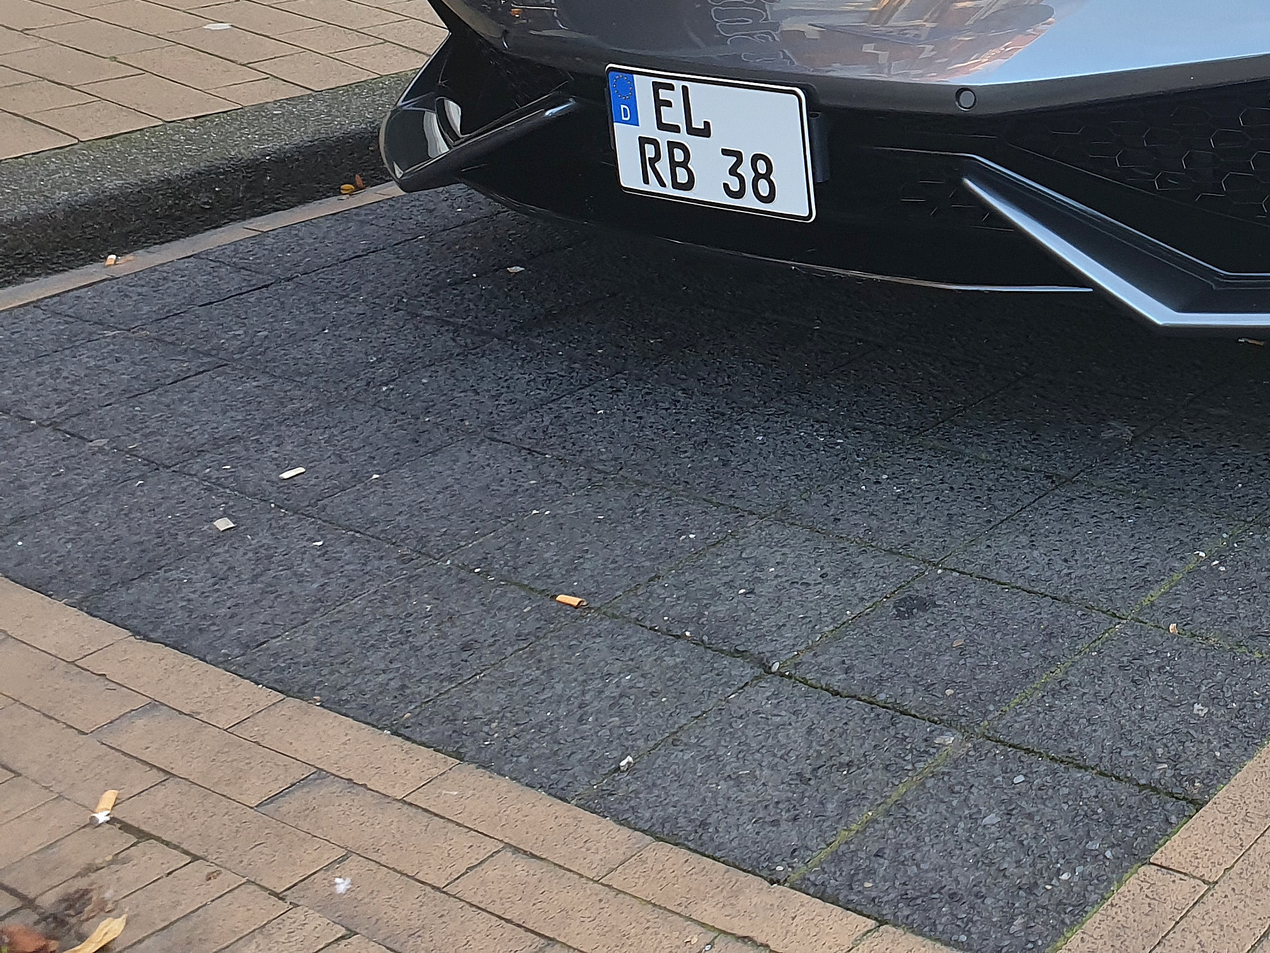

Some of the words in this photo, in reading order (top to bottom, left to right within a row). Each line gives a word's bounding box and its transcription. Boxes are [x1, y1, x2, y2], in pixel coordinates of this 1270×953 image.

[620, 105, 631, 121] D
[652, 81, 711, 138] EL
[638, 136, 695, 191] RB
[721, 148, 776, 204] 38
